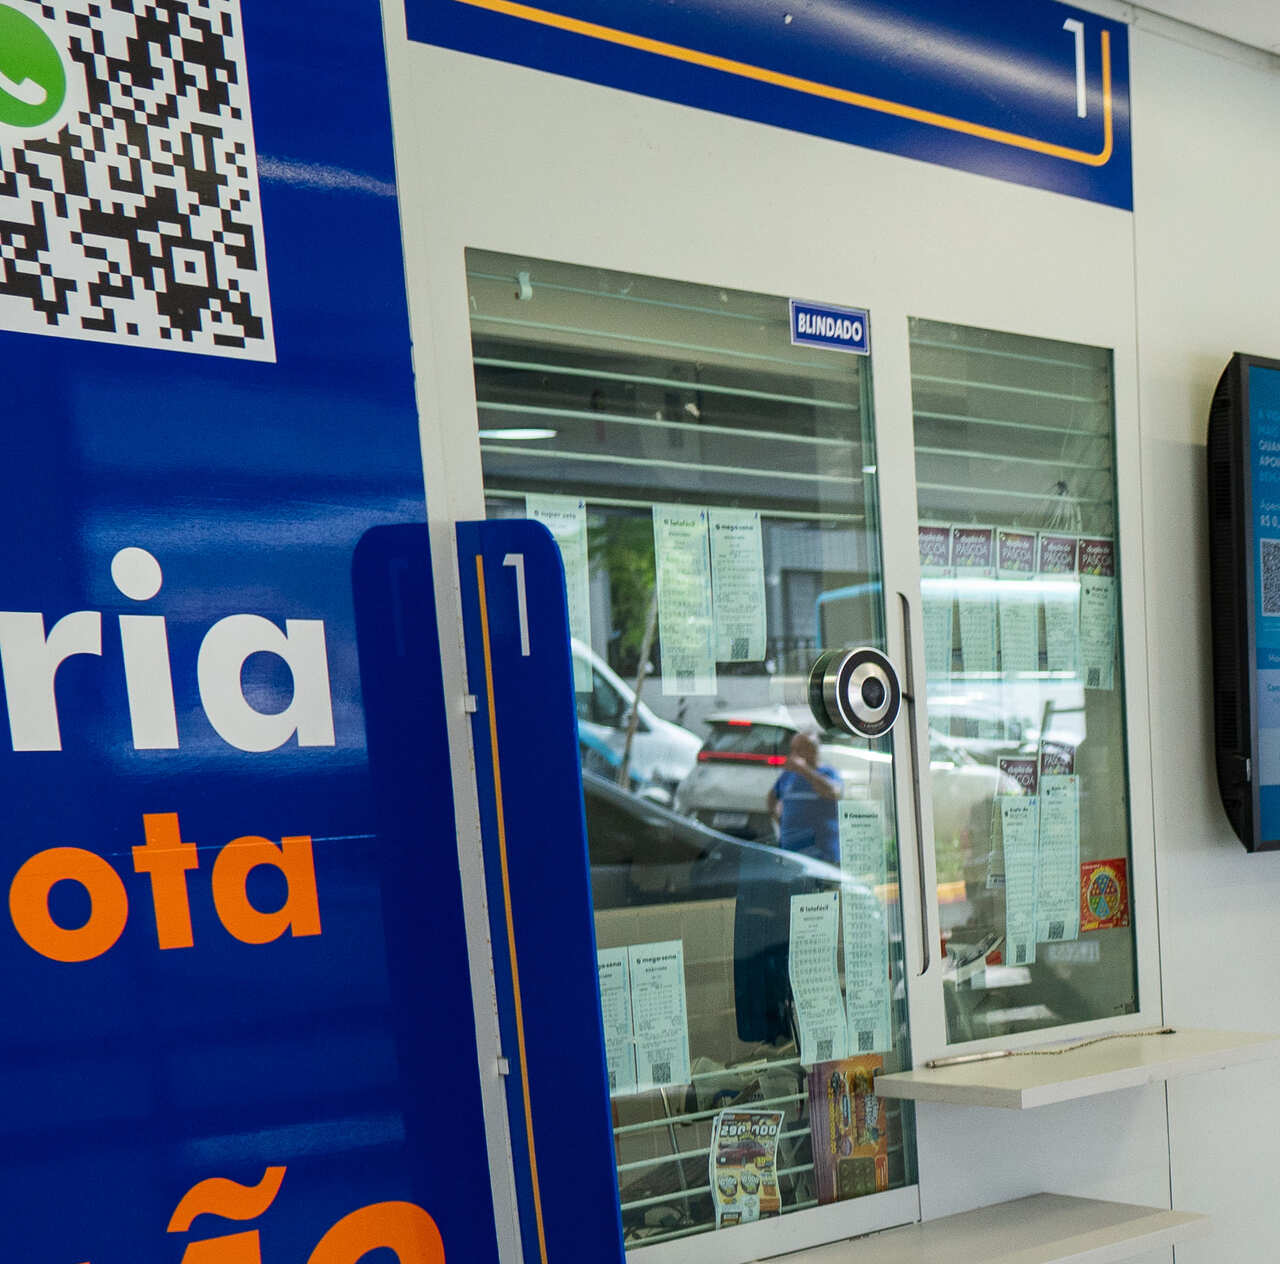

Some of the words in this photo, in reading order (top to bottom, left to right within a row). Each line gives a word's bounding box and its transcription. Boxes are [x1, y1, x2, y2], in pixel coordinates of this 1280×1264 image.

[1062, 17, 1088, 119] 1
[798, 312, 863, 342] BLINDADO
[0, 546, 336, 753] ria
[502, 552, 531, 657] 1
[9, 812, 322, 963] ota
